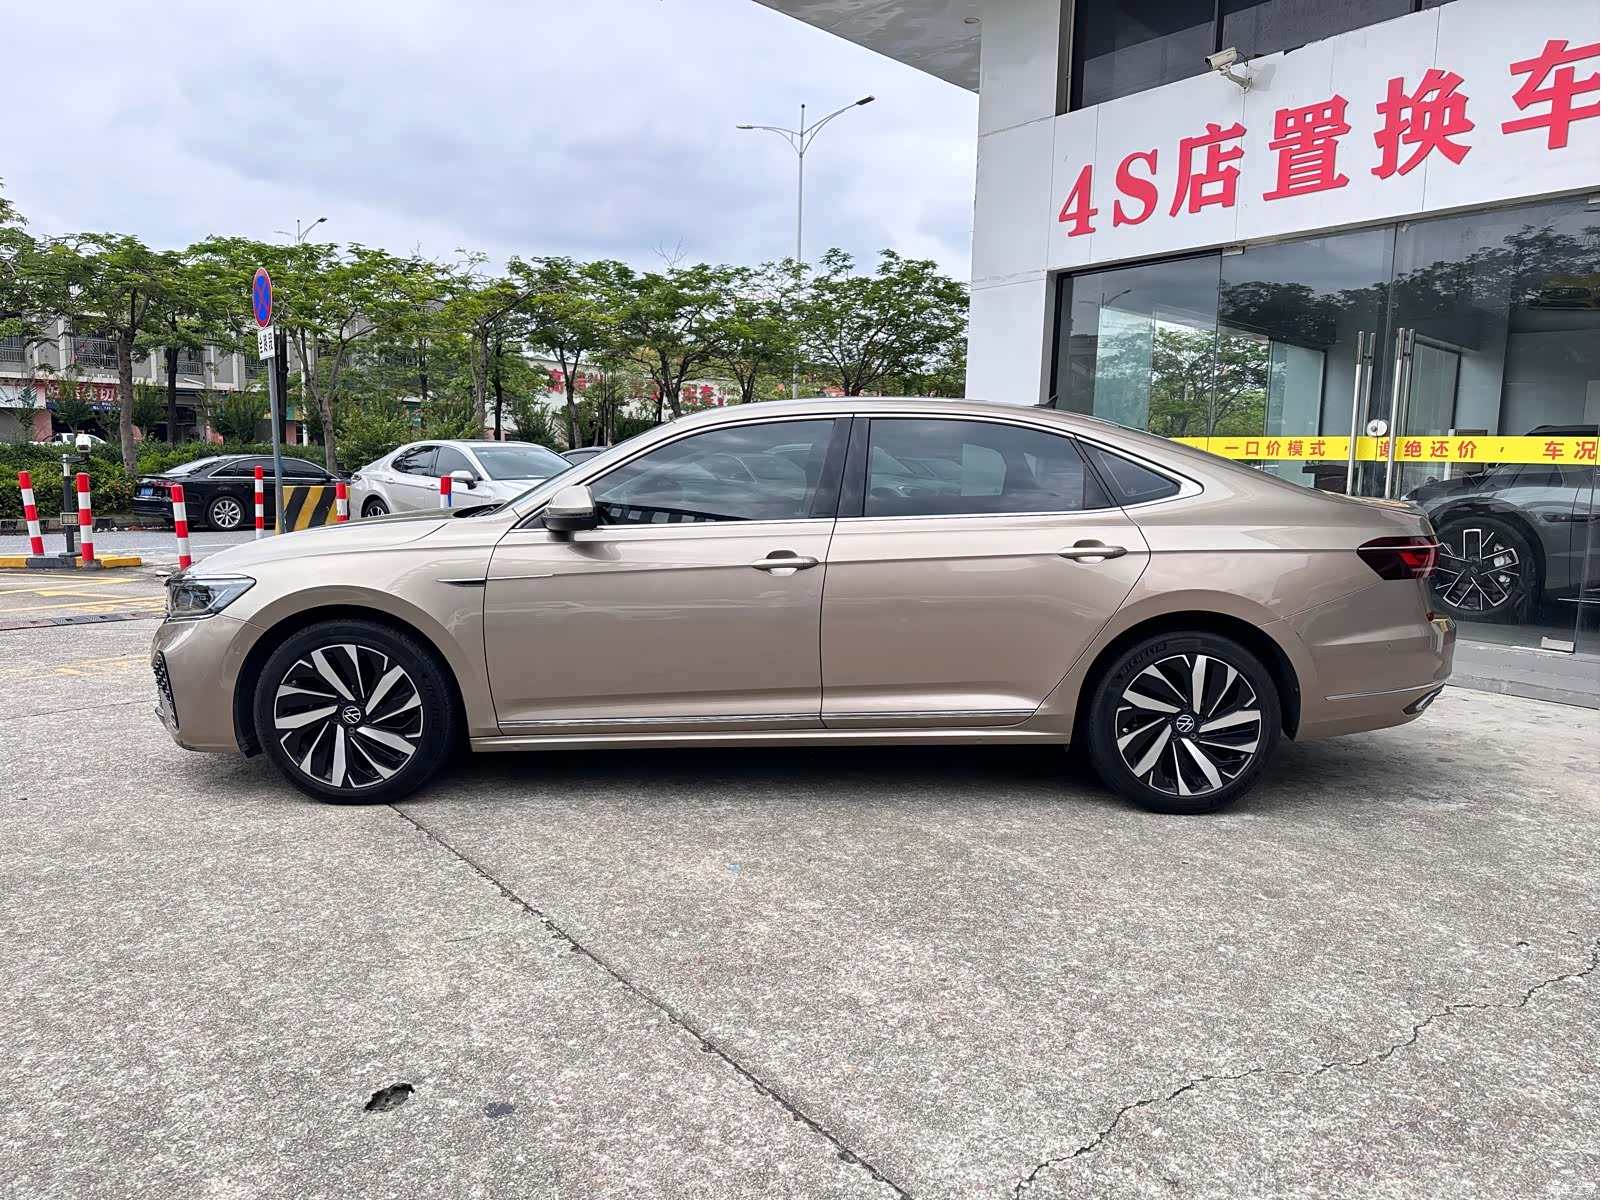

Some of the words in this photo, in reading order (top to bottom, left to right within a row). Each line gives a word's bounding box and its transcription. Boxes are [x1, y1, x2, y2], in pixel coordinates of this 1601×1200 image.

[1058, 39, 1600, 238] 4S店置换车
[1542, 440, 1598, 460] 车况
